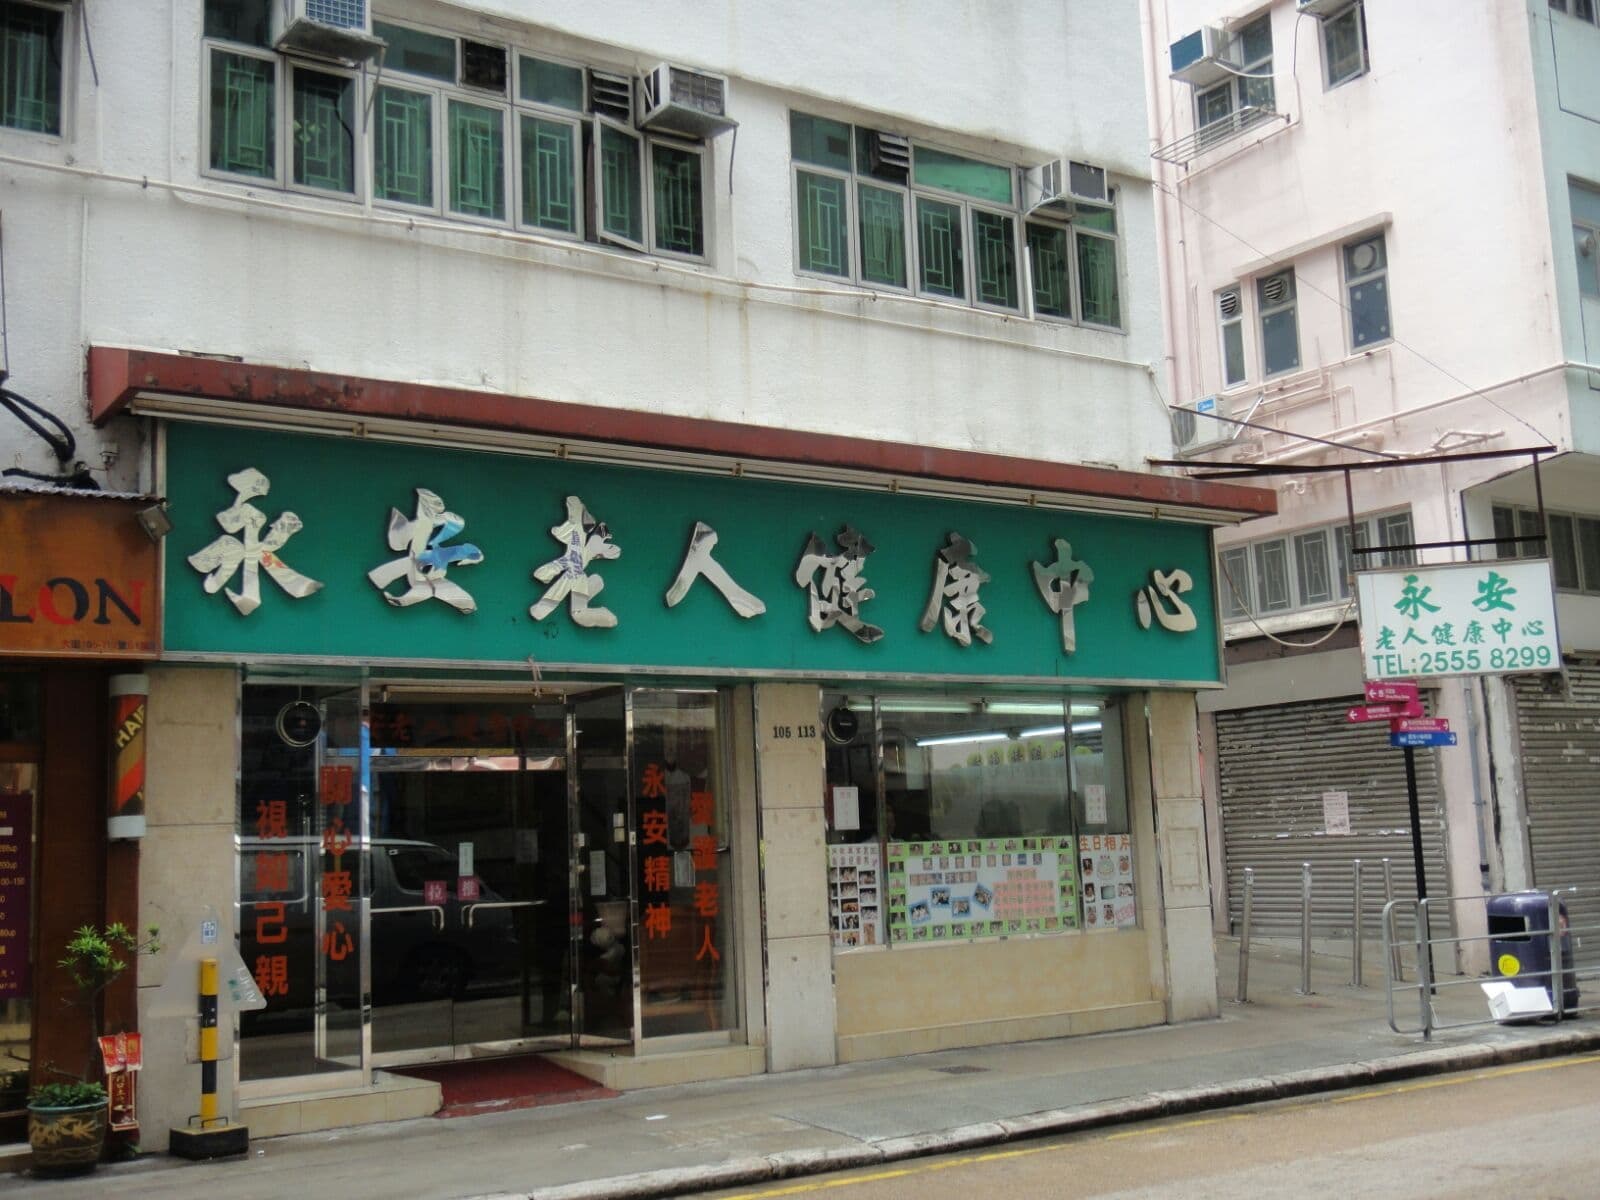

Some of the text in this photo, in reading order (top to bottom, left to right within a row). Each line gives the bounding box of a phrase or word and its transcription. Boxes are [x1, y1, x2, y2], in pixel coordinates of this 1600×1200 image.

[187, 467, 1199, 656] 永安老人健康中心
[1393, 571, 1518, 620] 永安
[1376, 618, 1545, 650] 老人健康中心
[1372, 645, 1551, 676] TEL:2555 8299
[773, 725, 816, 739] 105 113
[641, 763, 671, 939] 永安精神
